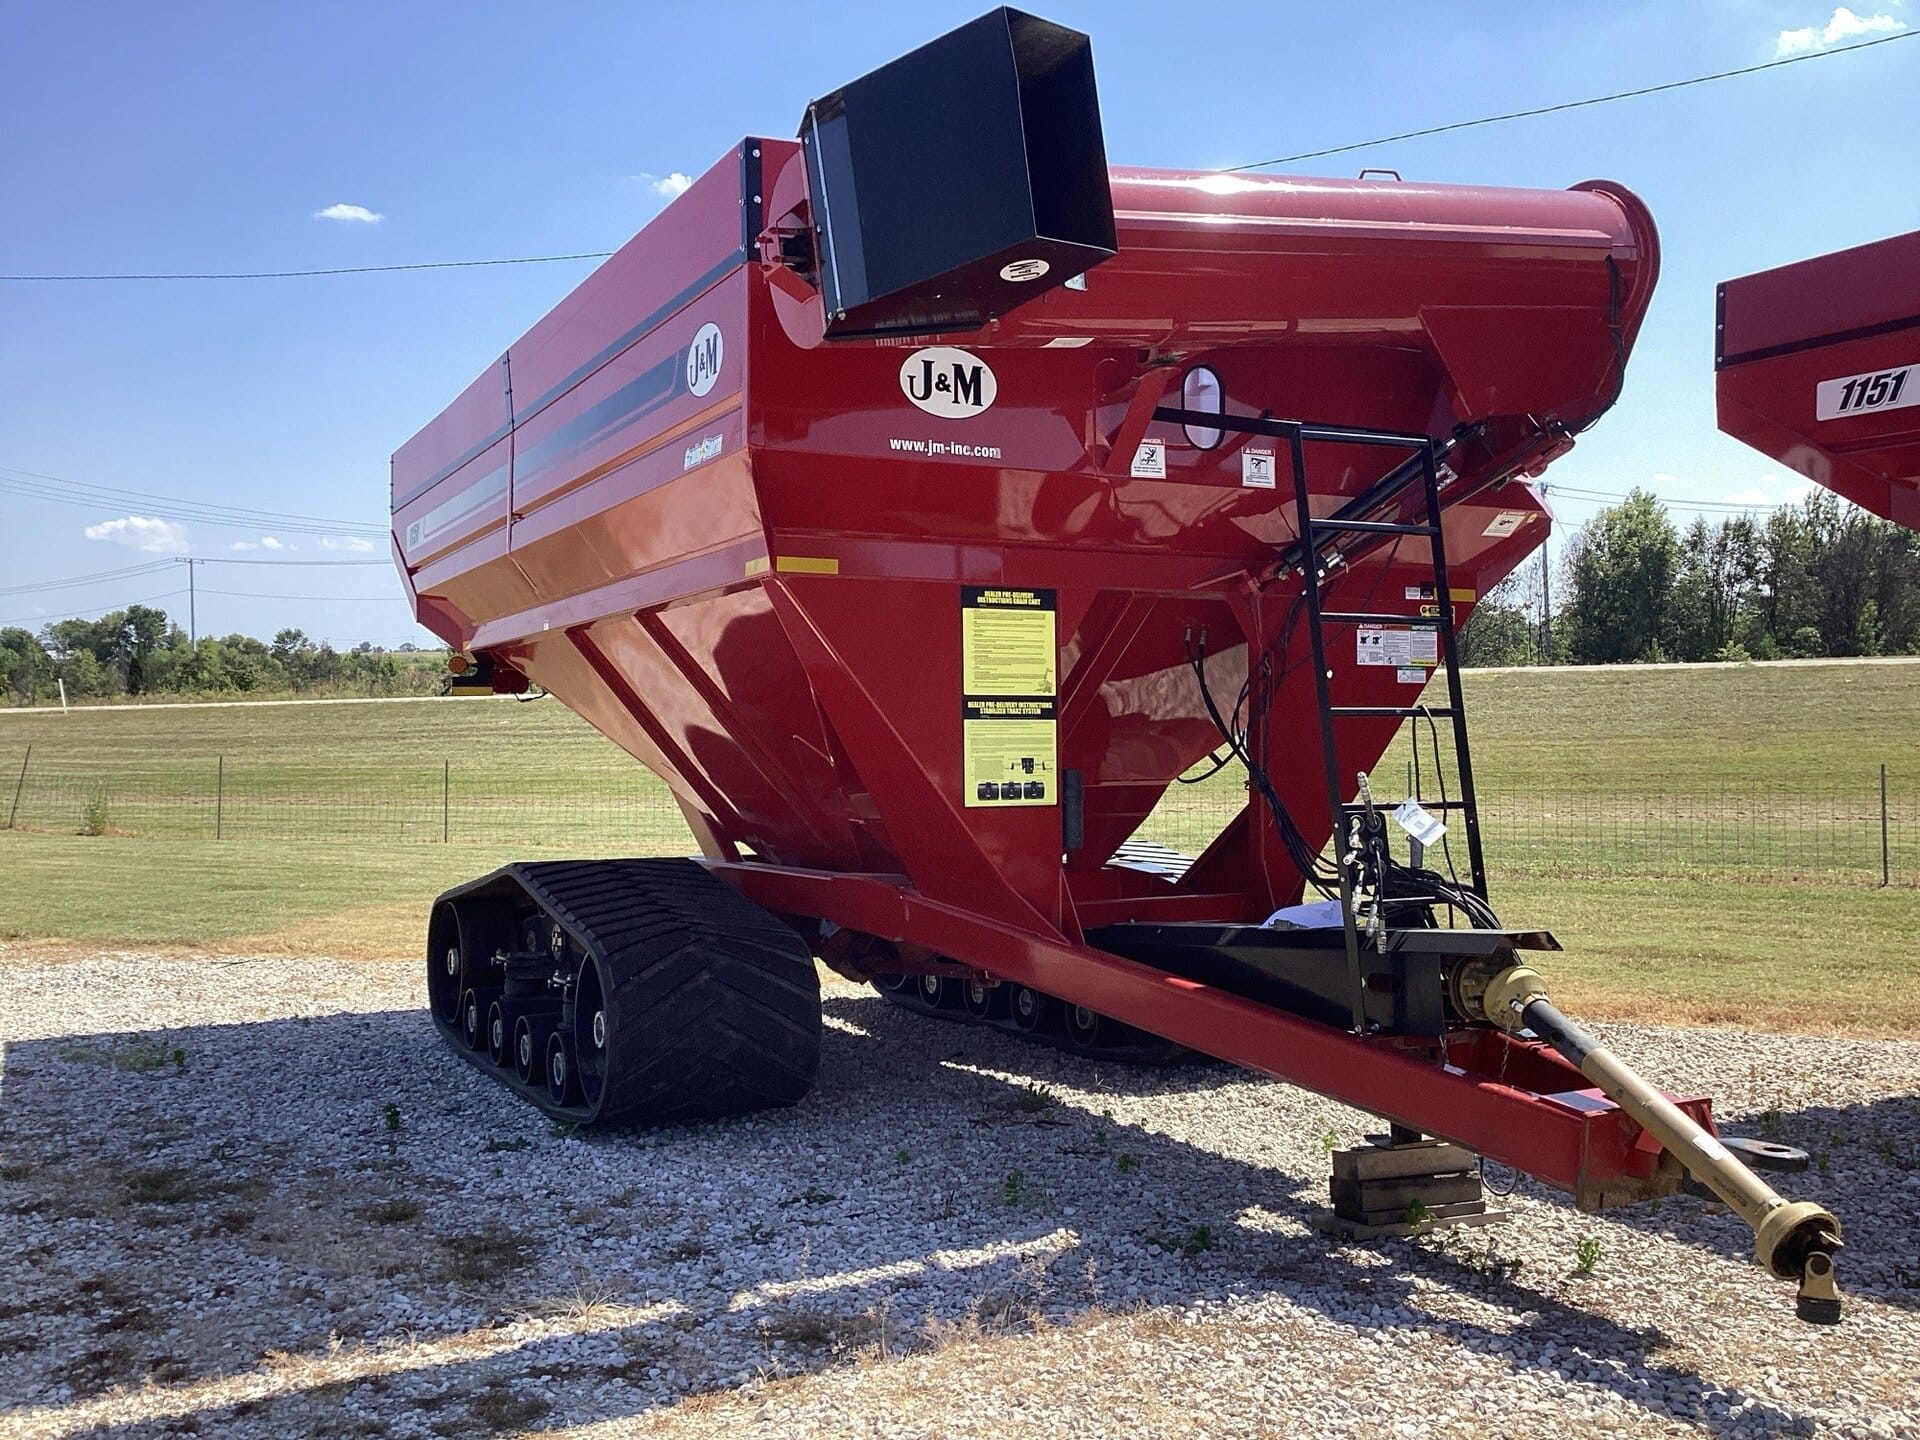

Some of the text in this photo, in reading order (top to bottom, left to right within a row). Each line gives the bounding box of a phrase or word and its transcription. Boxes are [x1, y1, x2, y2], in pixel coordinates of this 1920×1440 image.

[690, 332, 718, 387] J&M
[907, 359, 984, 407] J&M
[1838, 369, 1909, 412] 1151
[890, 438, 1001, 459] www.jm-inc.com
